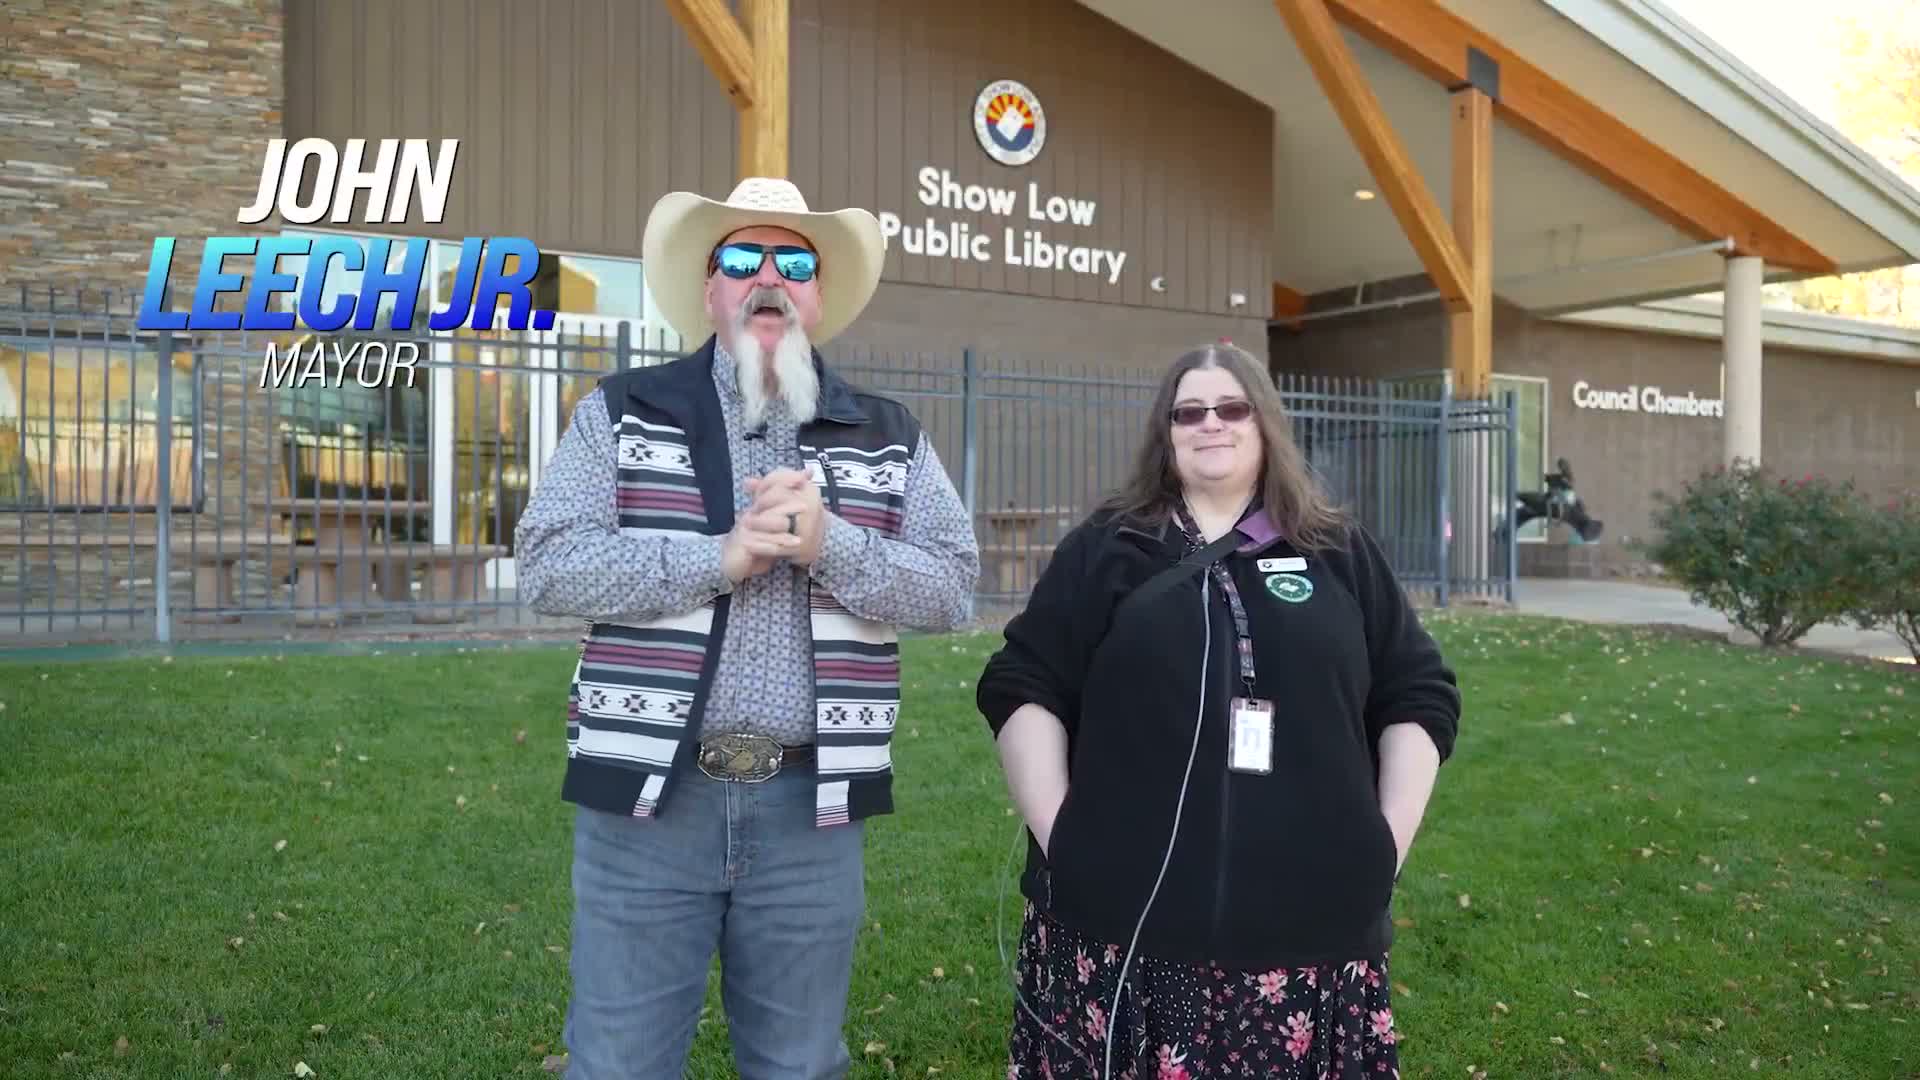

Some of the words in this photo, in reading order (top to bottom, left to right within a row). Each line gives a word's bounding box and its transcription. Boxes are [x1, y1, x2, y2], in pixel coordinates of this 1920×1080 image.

[918, 166, 1016, 216] Show
[1028, 182, 1096, 226] Low
[879, 211, 991, 261] Public
[1004, 227, 1127, 285] Library
[1572, 380, 1639, 412] Council
[1640, 386, 1724, 418] Chambers
